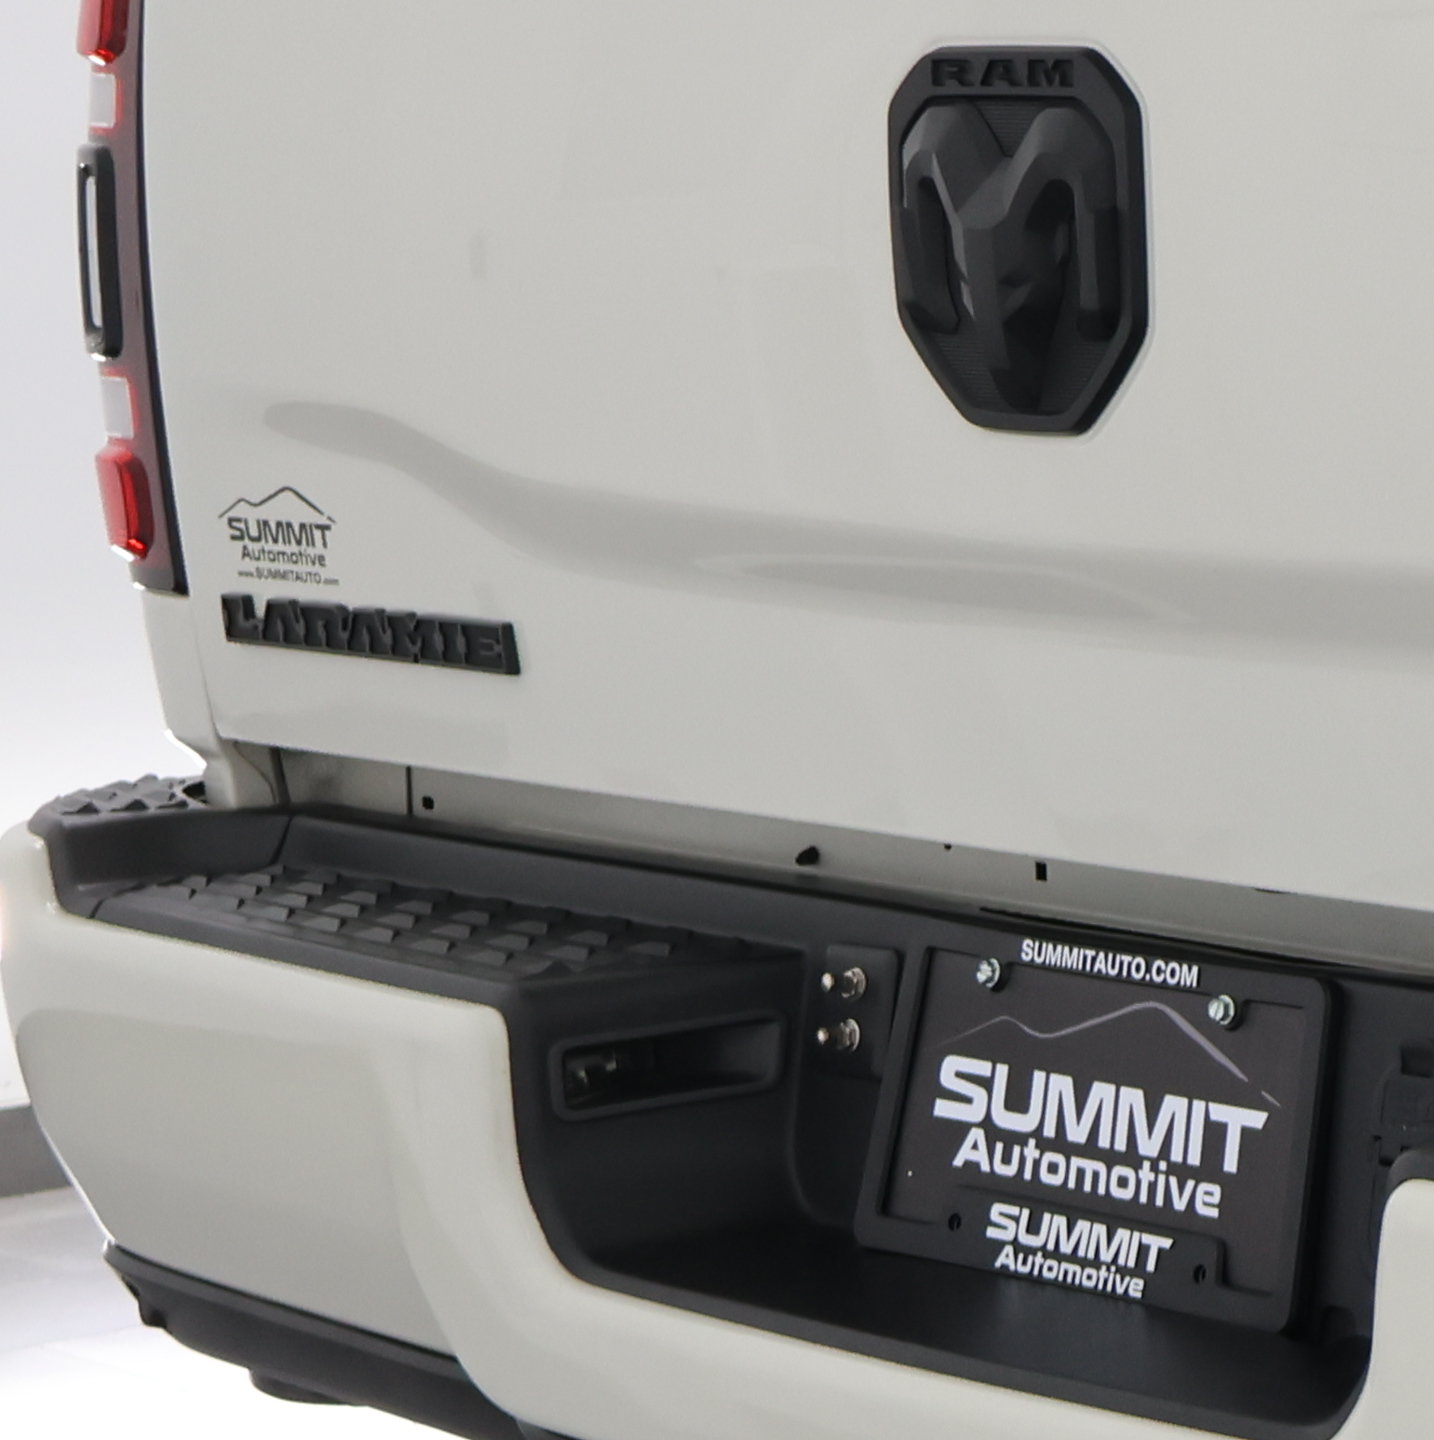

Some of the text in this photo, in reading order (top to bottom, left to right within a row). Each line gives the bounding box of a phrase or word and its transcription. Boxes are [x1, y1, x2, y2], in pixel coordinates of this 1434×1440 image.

[931, 59, 1075, 88] RAM
[227, 516, 332, 549] SUMMIT
[241, 544, 326, 568] Automotive
[221, 594, 521, 676] LARAMIE
[1020, 938, 1199, 989] SUMMITAUTO.COM
[933, 1054, 1270, 1175] SUMMIT
[952, 1126, 1223, 1220] Automotive
[985, 1202, 1175, 1274] SUMMIT
[994, 1244, 1146, 1301] Automotive
